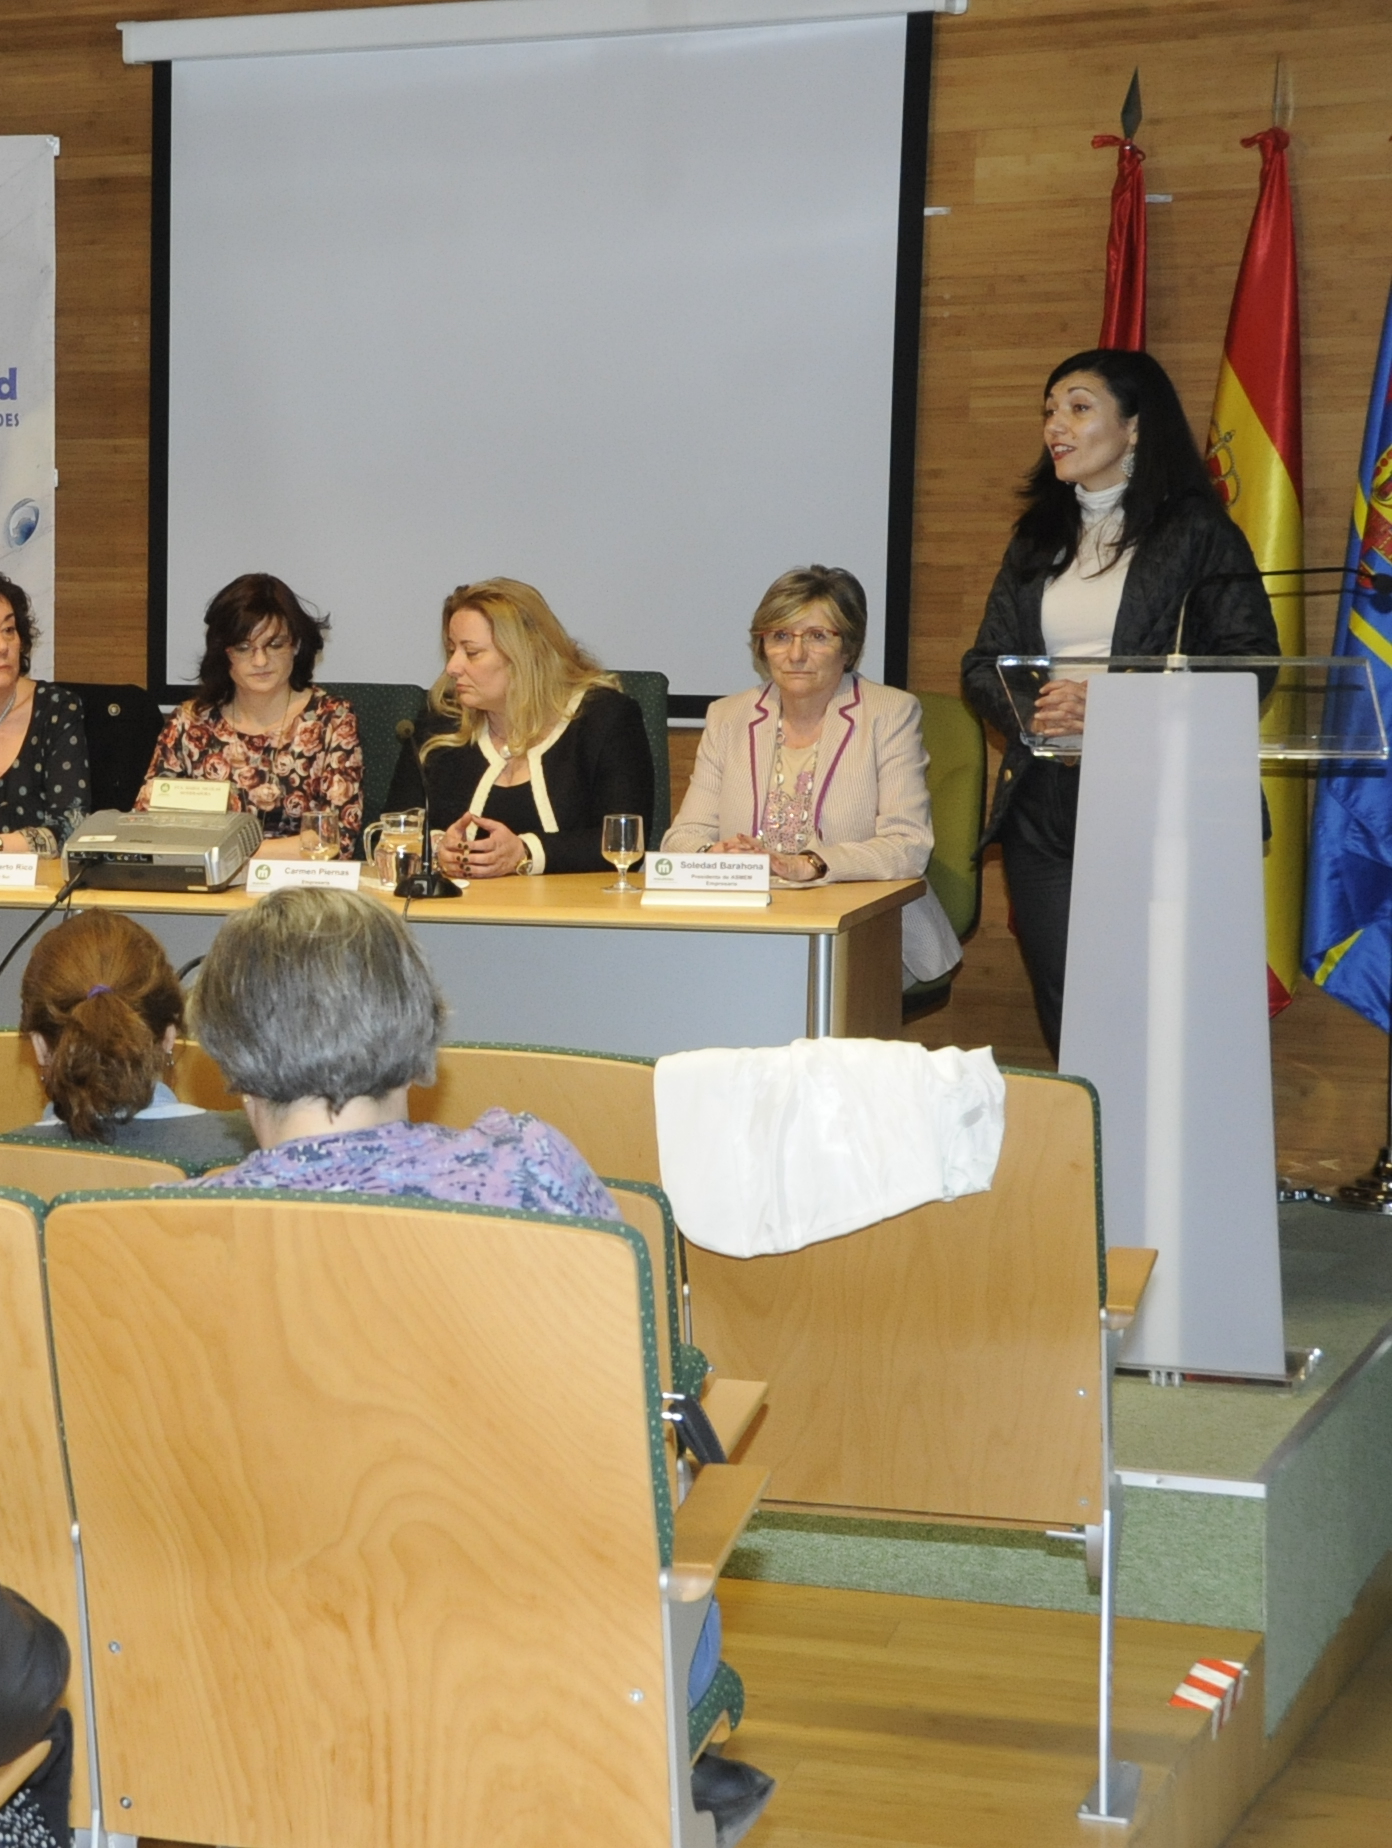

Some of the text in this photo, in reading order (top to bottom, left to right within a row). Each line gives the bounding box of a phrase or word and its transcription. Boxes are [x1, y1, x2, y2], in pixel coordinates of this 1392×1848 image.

[680, 861, 764, 870] Soledad Barahona
[284, 867, 349, 876] Carmen Piernas
